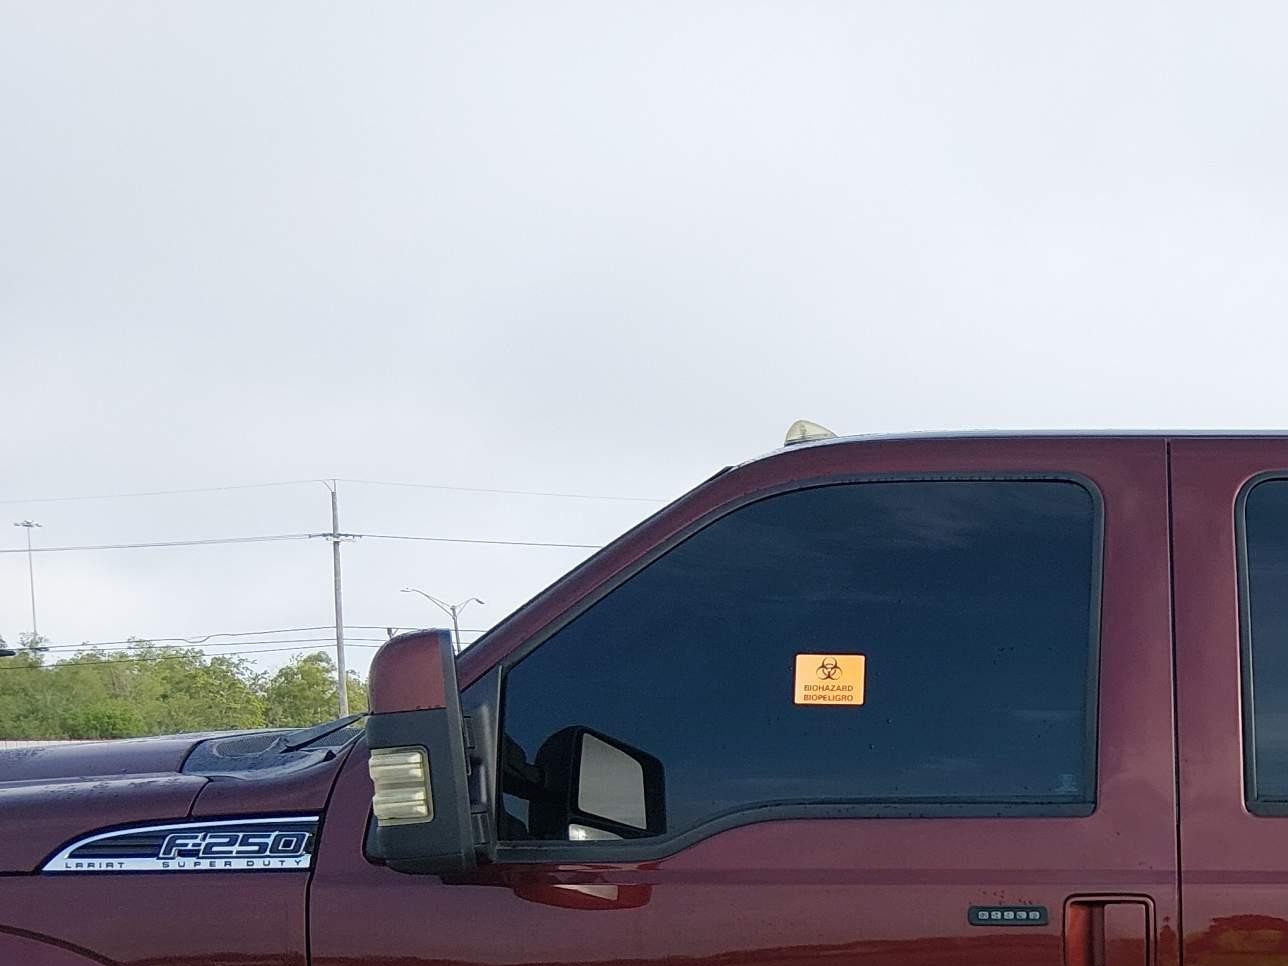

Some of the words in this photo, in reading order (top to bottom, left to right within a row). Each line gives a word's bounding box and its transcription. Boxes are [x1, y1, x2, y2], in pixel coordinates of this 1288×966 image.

[803, 684, 854, 692] BIOHAZARD
[803, 694, 854, 702] BIOPELIGRO
[158, 831, 312, 858] F-250
[64, 861, 126, 869] LARIAT
[162, 860, 232, 868] SUPER
[246, 859, 304, 868] DUTY
